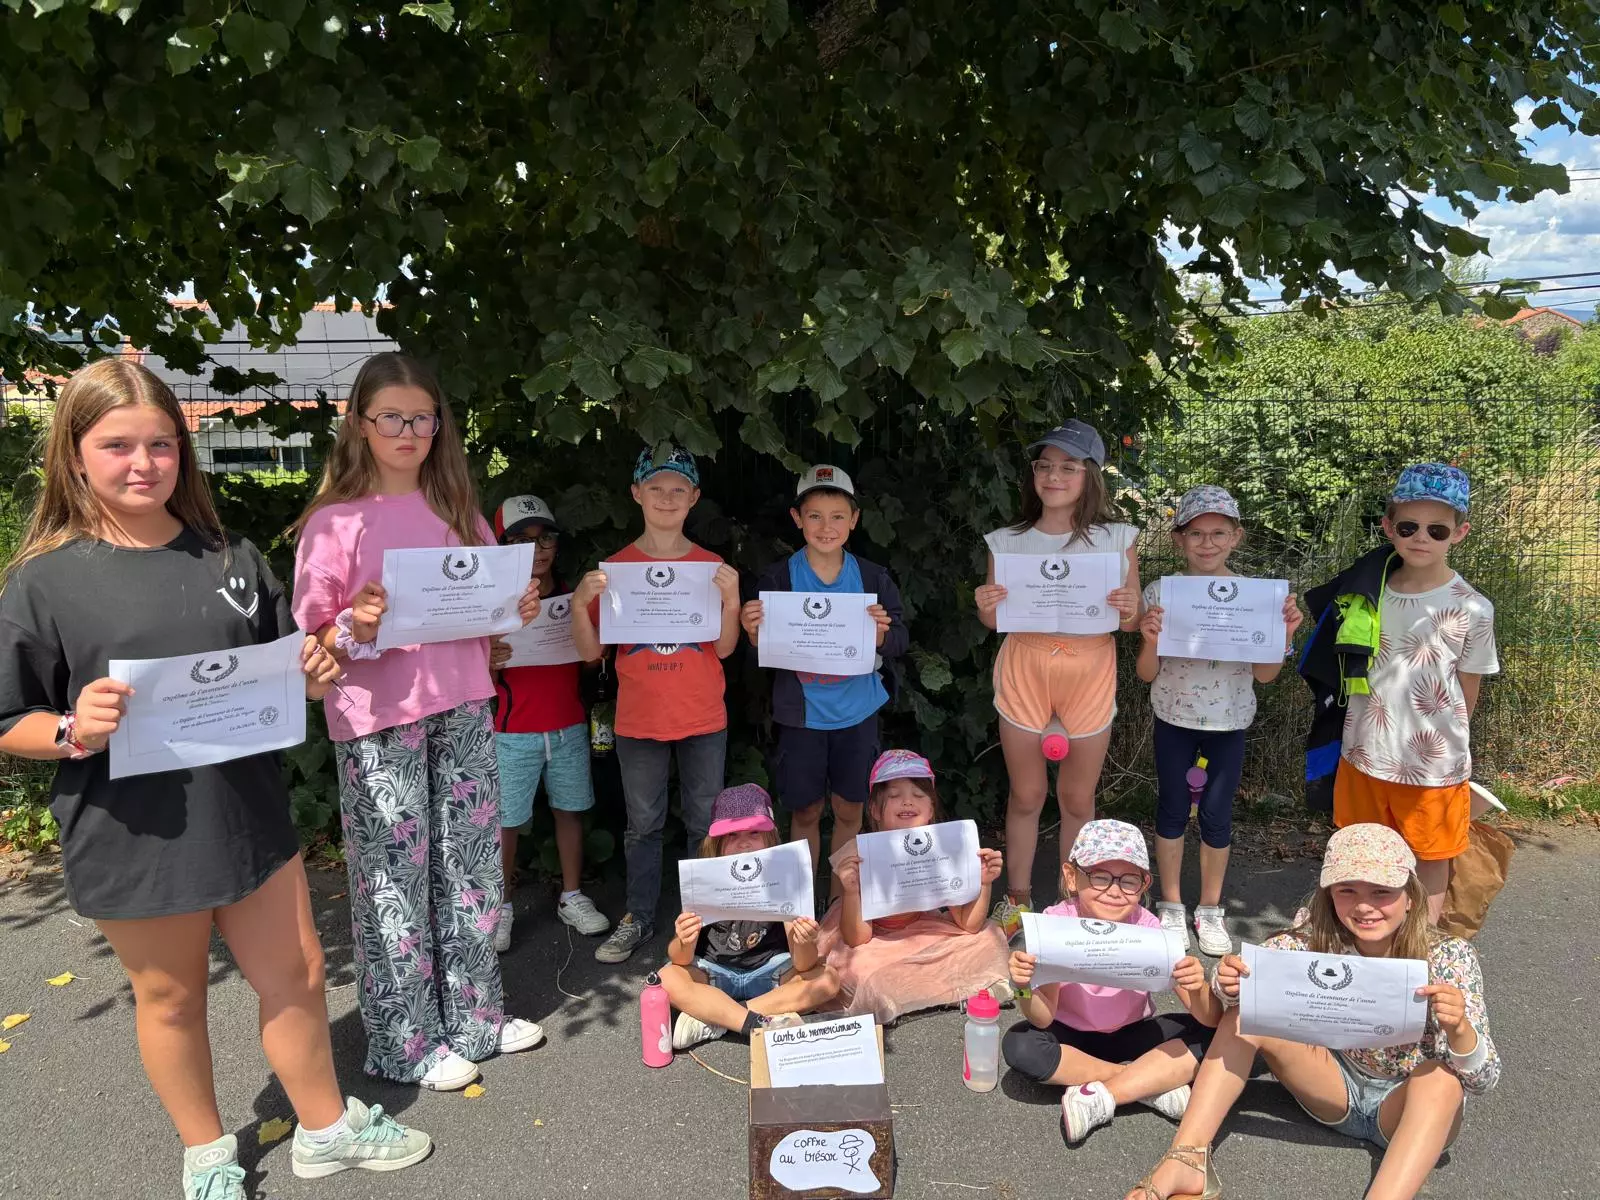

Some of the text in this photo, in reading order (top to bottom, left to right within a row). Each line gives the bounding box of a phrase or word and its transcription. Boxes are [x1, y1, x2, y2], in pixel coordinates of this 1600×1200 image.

[772, 1029, 796, 1043] Carte
[796, 1026, 808, 1039] de
[779, 1150, 838, 1164] au trésor
